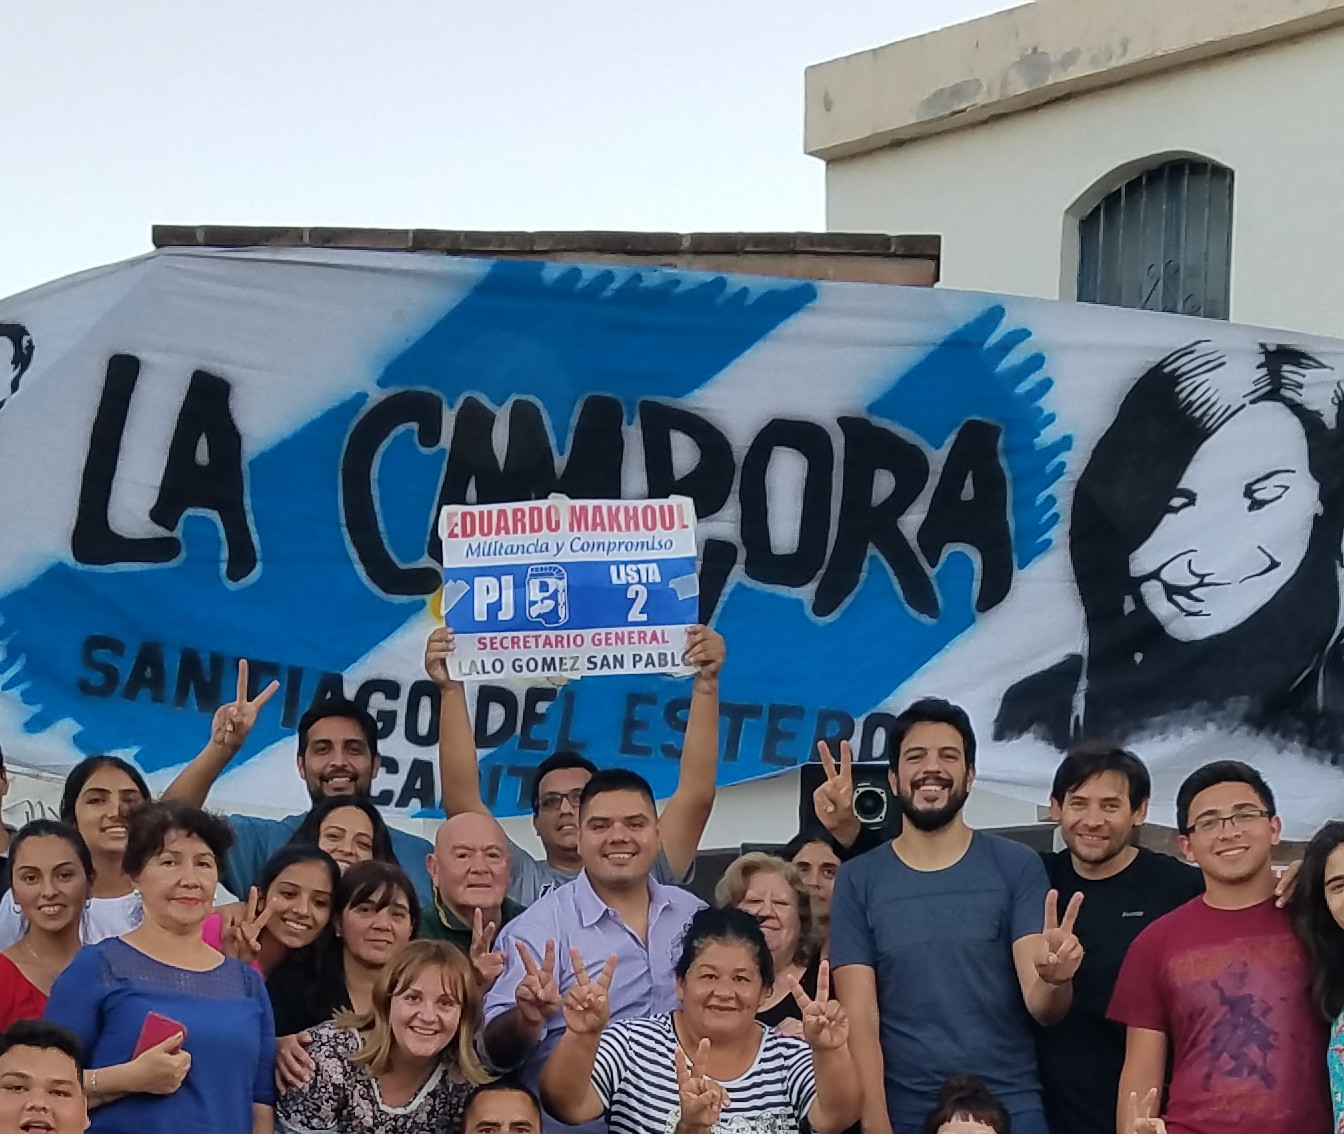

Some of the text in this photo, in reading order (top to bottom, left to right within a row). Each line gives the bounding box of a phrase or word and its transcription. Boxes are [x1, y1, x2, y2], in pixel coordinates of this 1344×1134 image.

[71, 354, 256, 583] LA
[446, 503, 690, 540] EDUARDO MAKHOUL
[465, 535, 674, 559] Militancia y Compromiso
[609, 563, 662, 585] LISTA
[473, 574, 515, 622] PJ
[626, 584, 648, 623] 2
[476, 629, 670, 651] SECRETARIO GENERAL
[458, 658, 505, 676] LALO
[511, 655, 580, 674] GOMEZ
[586, 654, 629, 671] SAN
[474, 685, 586, 753] DEL
